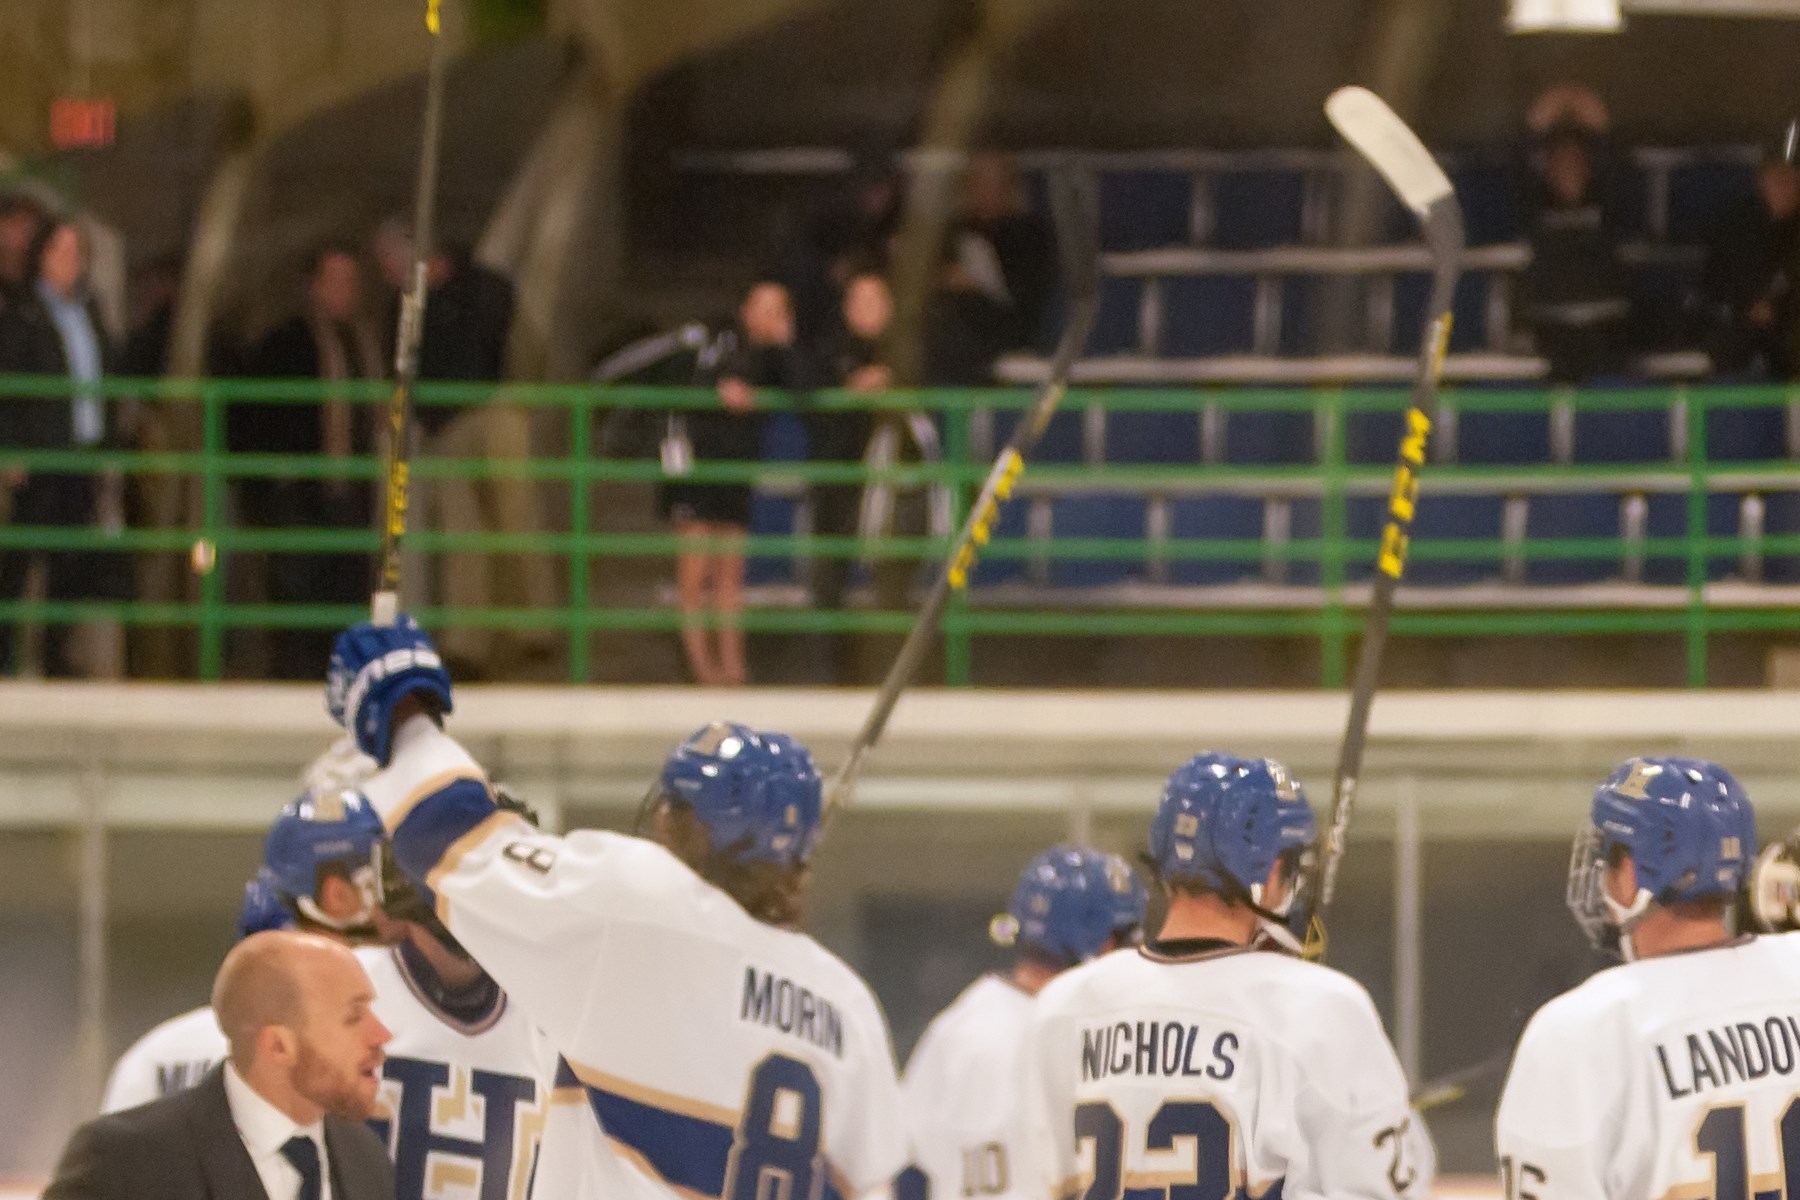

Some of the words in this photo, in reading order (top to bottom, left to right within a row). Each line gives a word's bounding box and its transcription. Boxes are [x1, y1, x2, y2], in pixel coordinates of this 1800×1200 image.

[740, 965, 843, 1060] MORIN
[1081, 1020, 1240, 1083] NICHOLS
[960, 1140, 1008, 1199] 10
